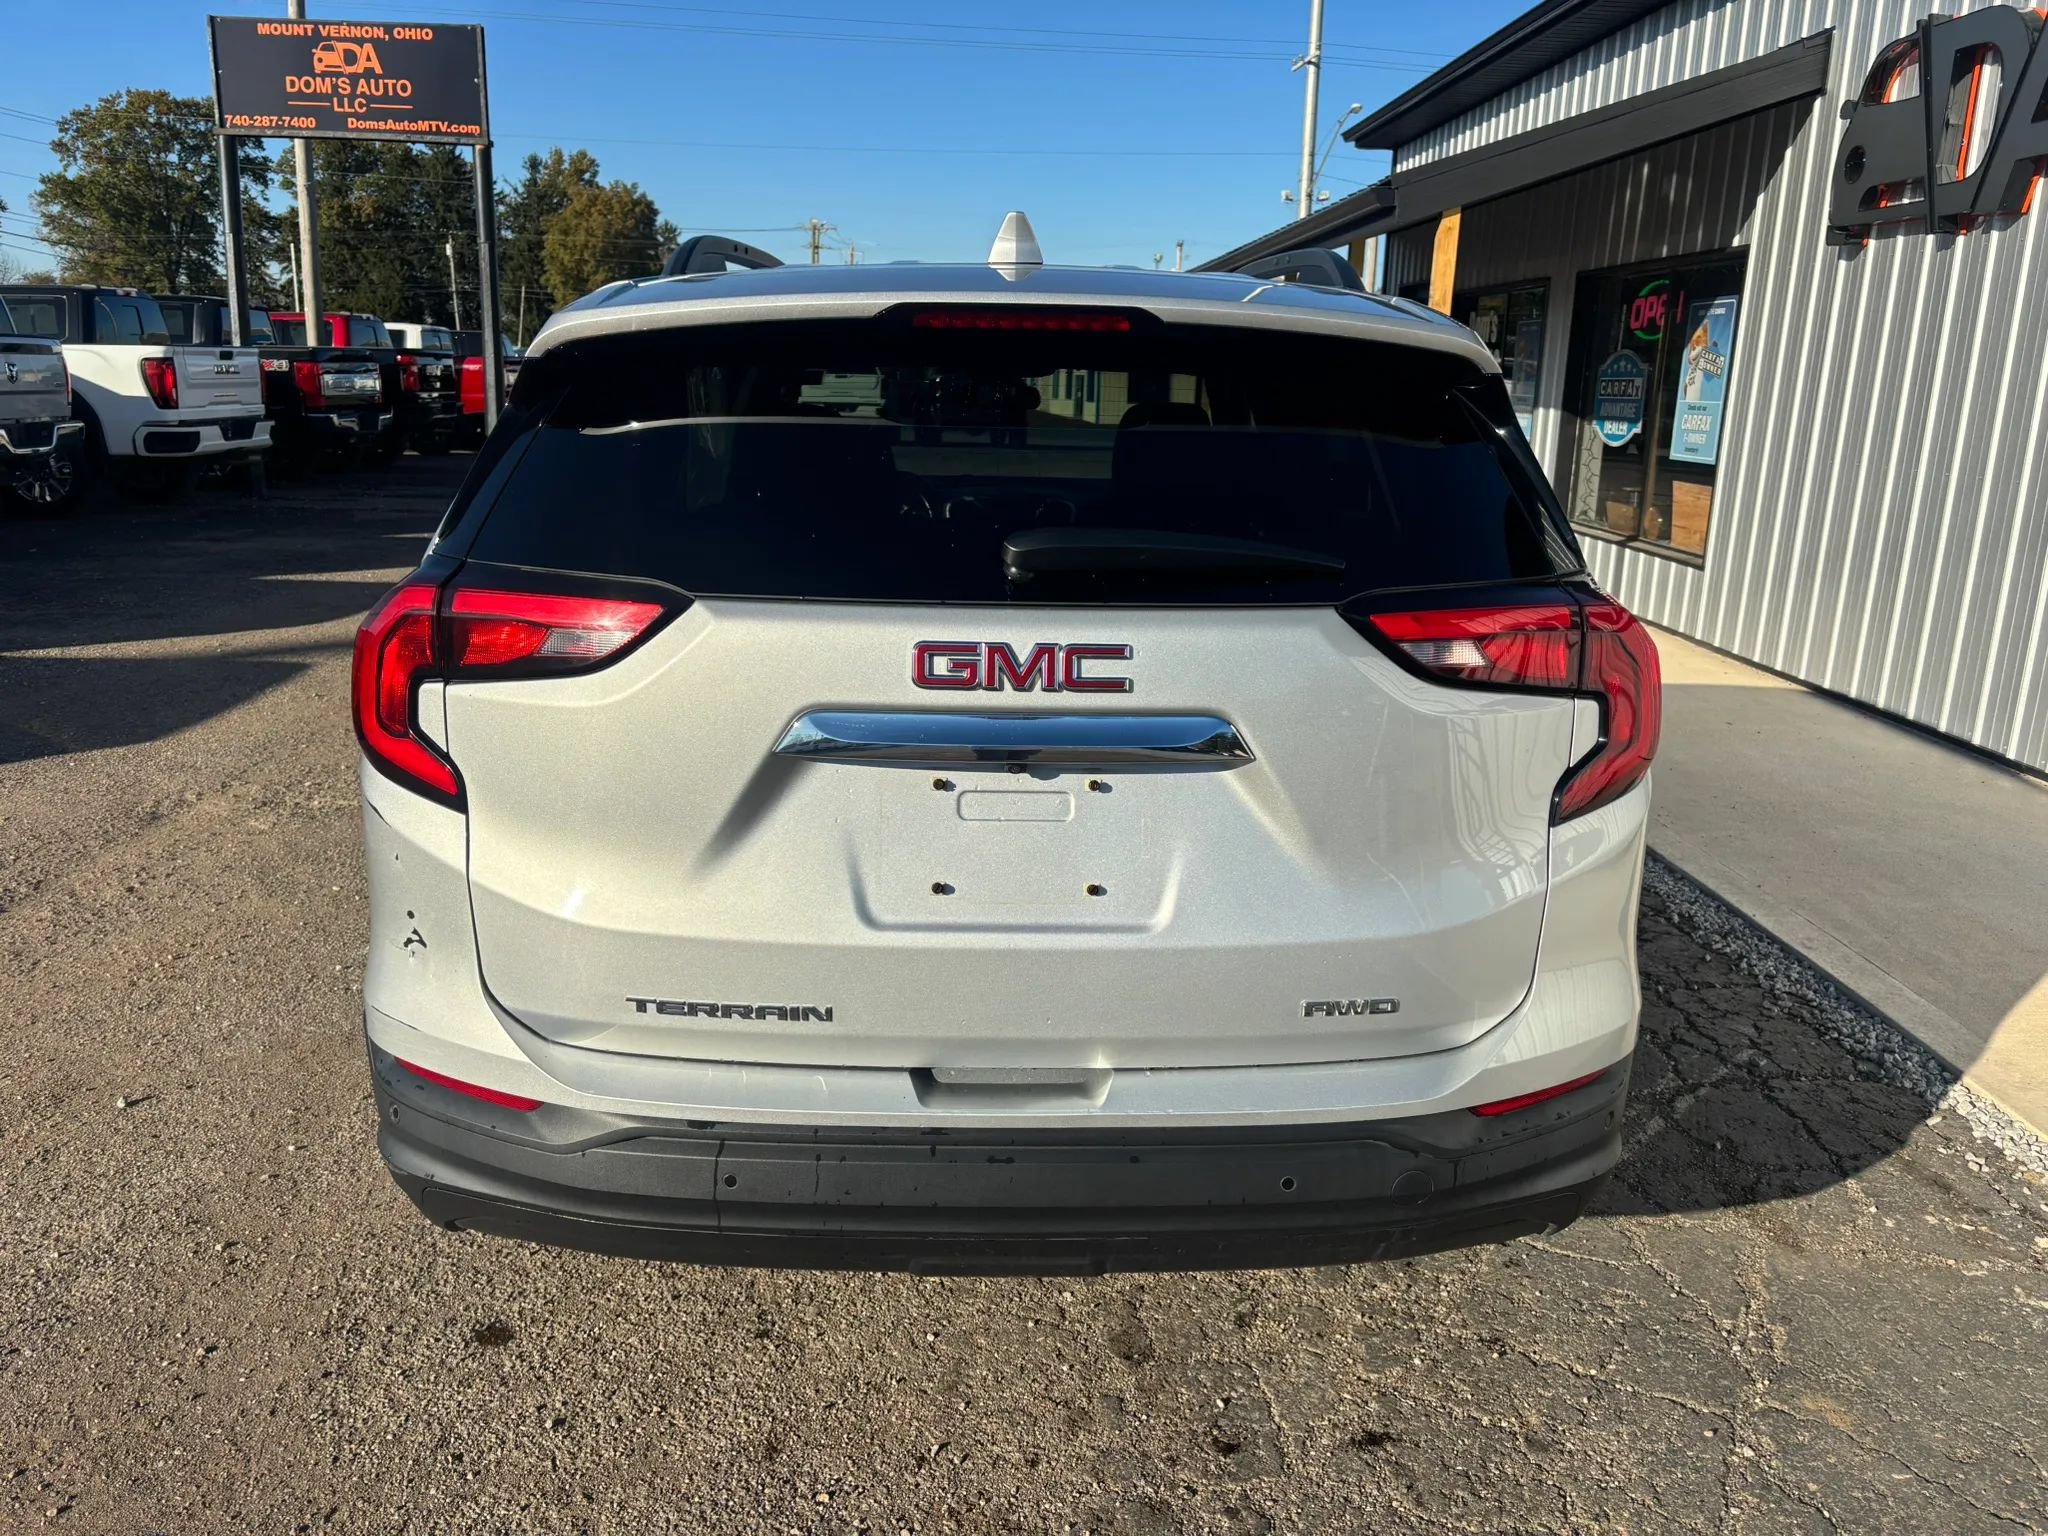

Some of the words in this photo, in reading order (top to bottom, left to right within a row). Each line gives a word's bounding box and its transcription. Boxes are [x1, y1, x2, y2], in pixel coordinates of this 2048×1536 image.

[257, 22, 314, 37] MOUNT
[319, 24, 389, 42] VERNON,
[393, 27, 433, 41] OHIO
[285, 75, 351, 95] DOM'S
[356, 78, 412, 97] AUTO
[333, 97, 367, 114] LLC
[224, 114, 316, 129] 740-287-7400
[347, 117, 481, 136] DomsAutoMTV.com
[1600, 380, 1641, 398] CARFAX
[1681, 414, 1712, 432] CARFAX
[911, 640, 1134, 693] GMC
[625, 996, 833, 1022] TERRAIN
[1300, 997, 1400, 1017] AWD
